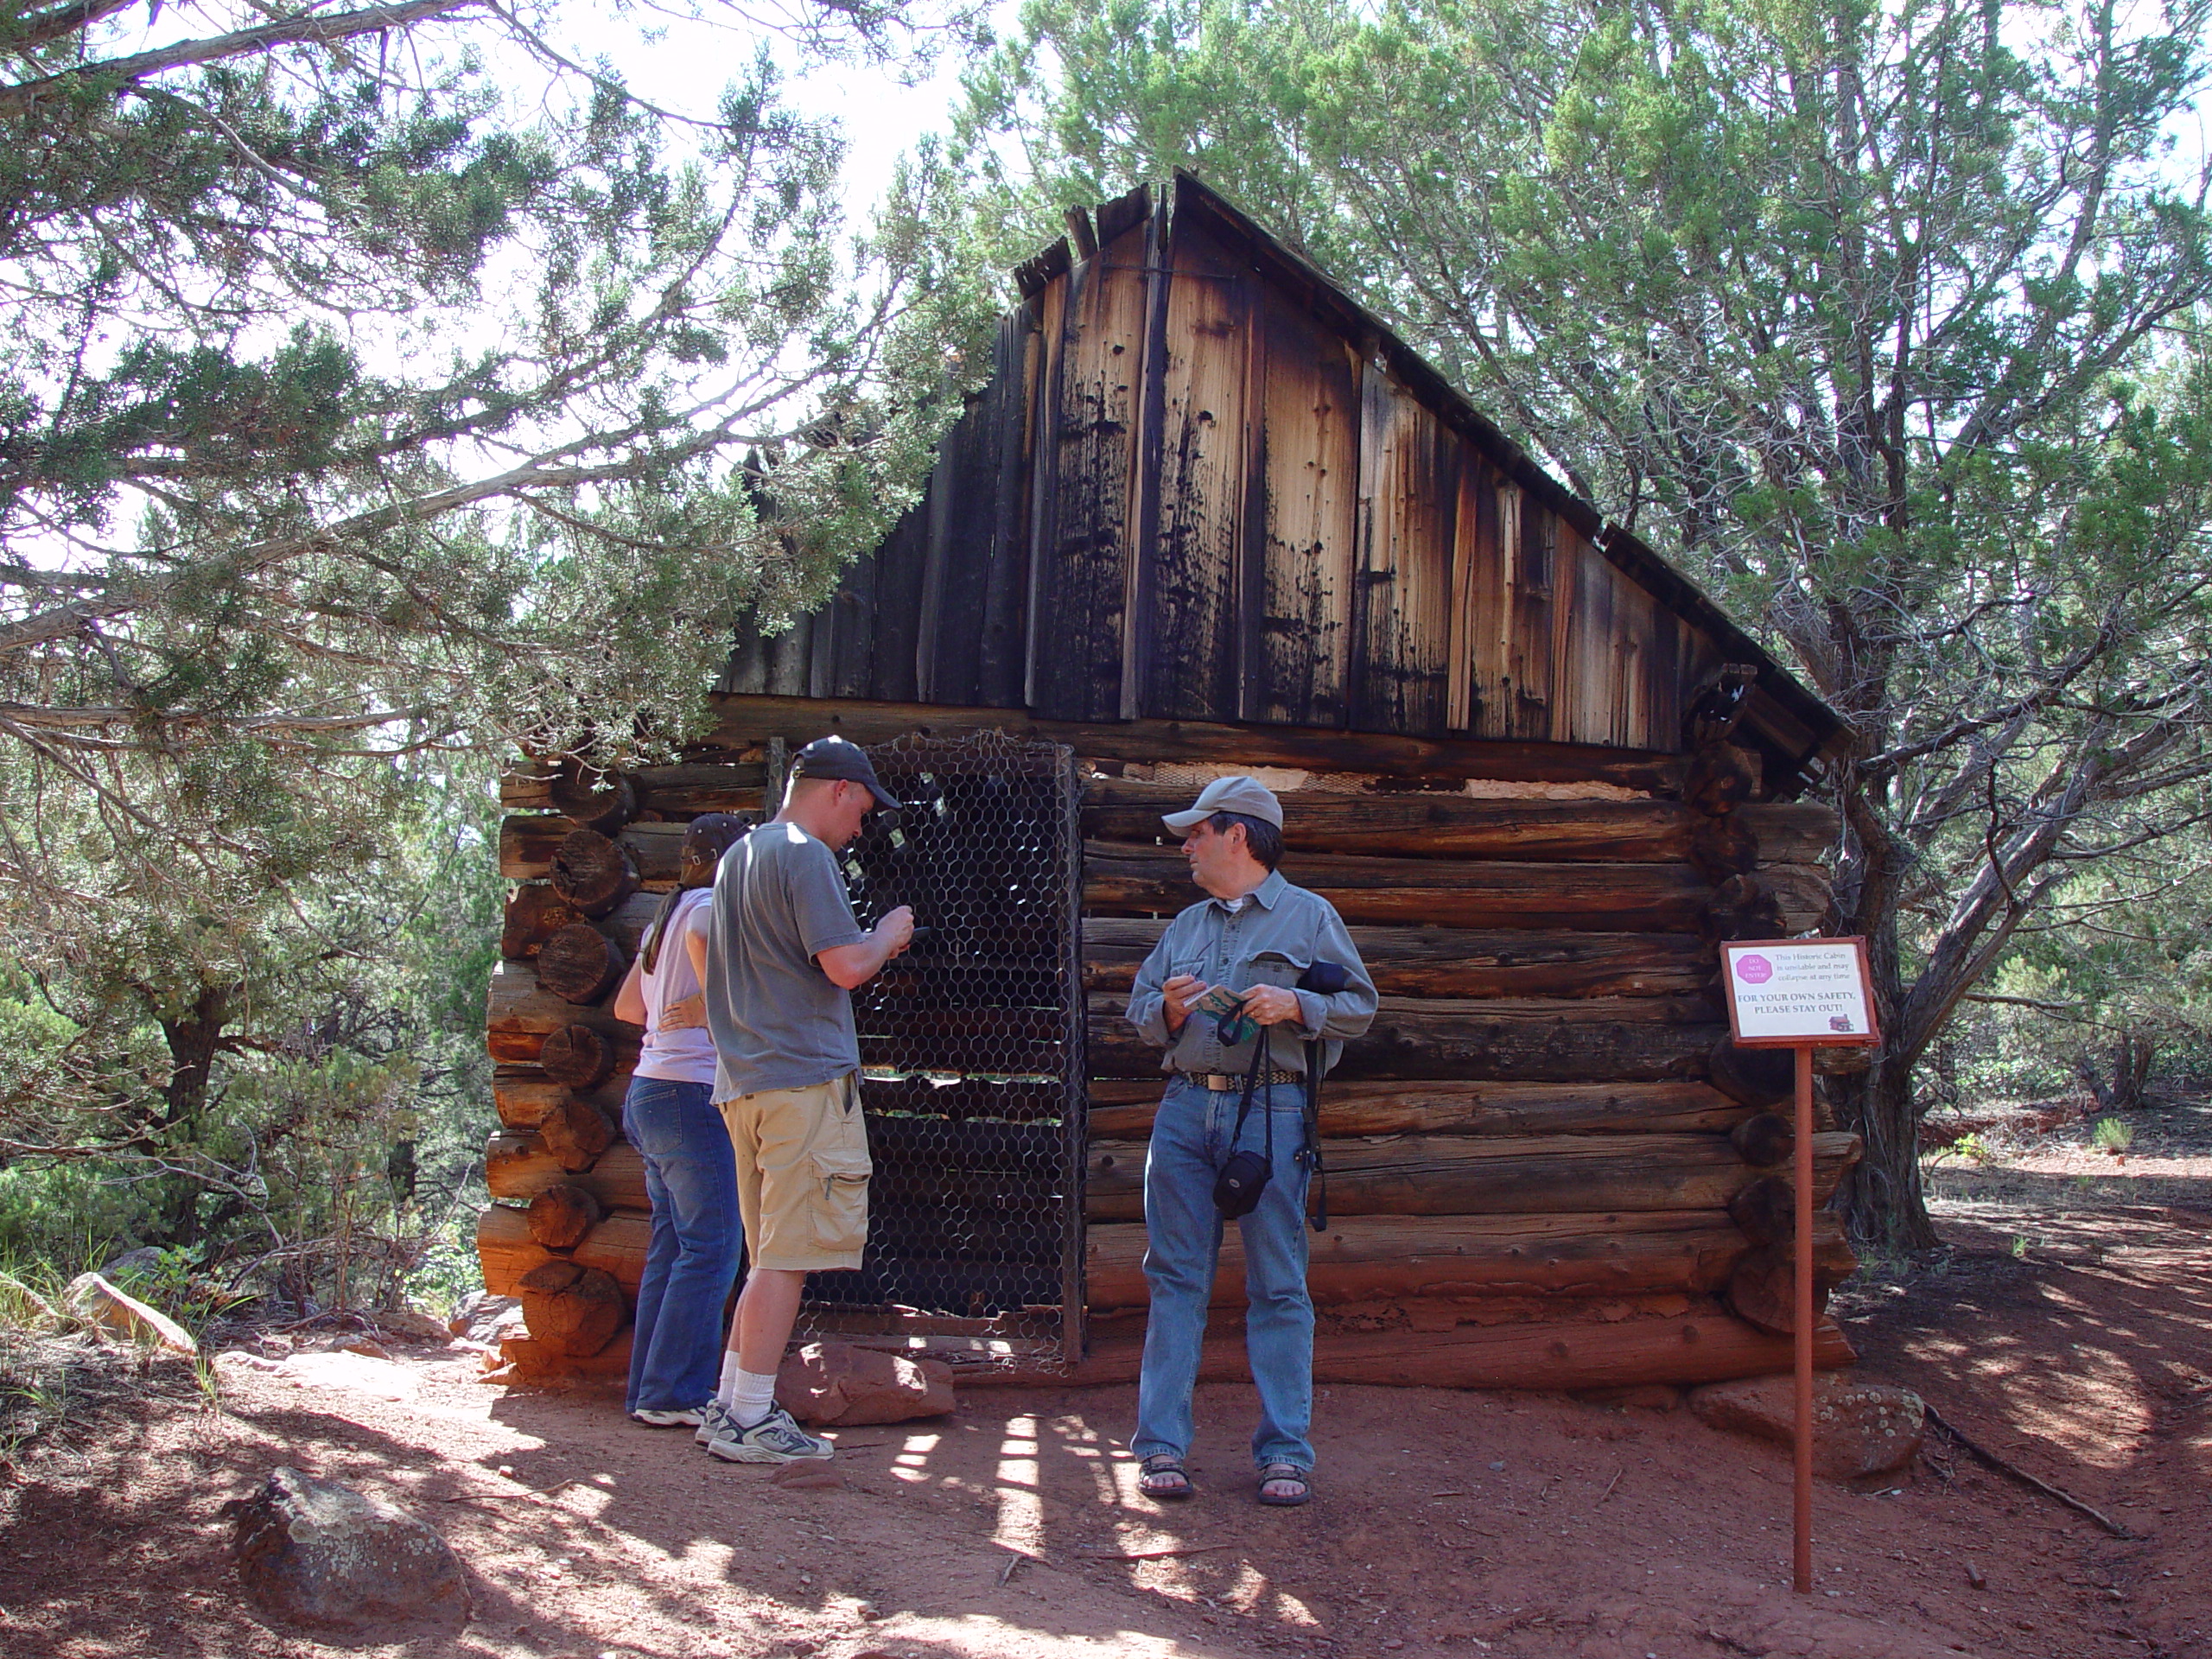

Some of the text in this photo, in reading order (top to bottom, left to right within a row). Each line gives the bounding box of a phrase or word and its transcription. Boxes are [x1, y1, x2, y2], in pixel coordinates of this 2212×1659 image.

[1778, 974, 1808, 982] collapse
[1754, 1003, 1843, 1014] PLEASE STAY OUT!
